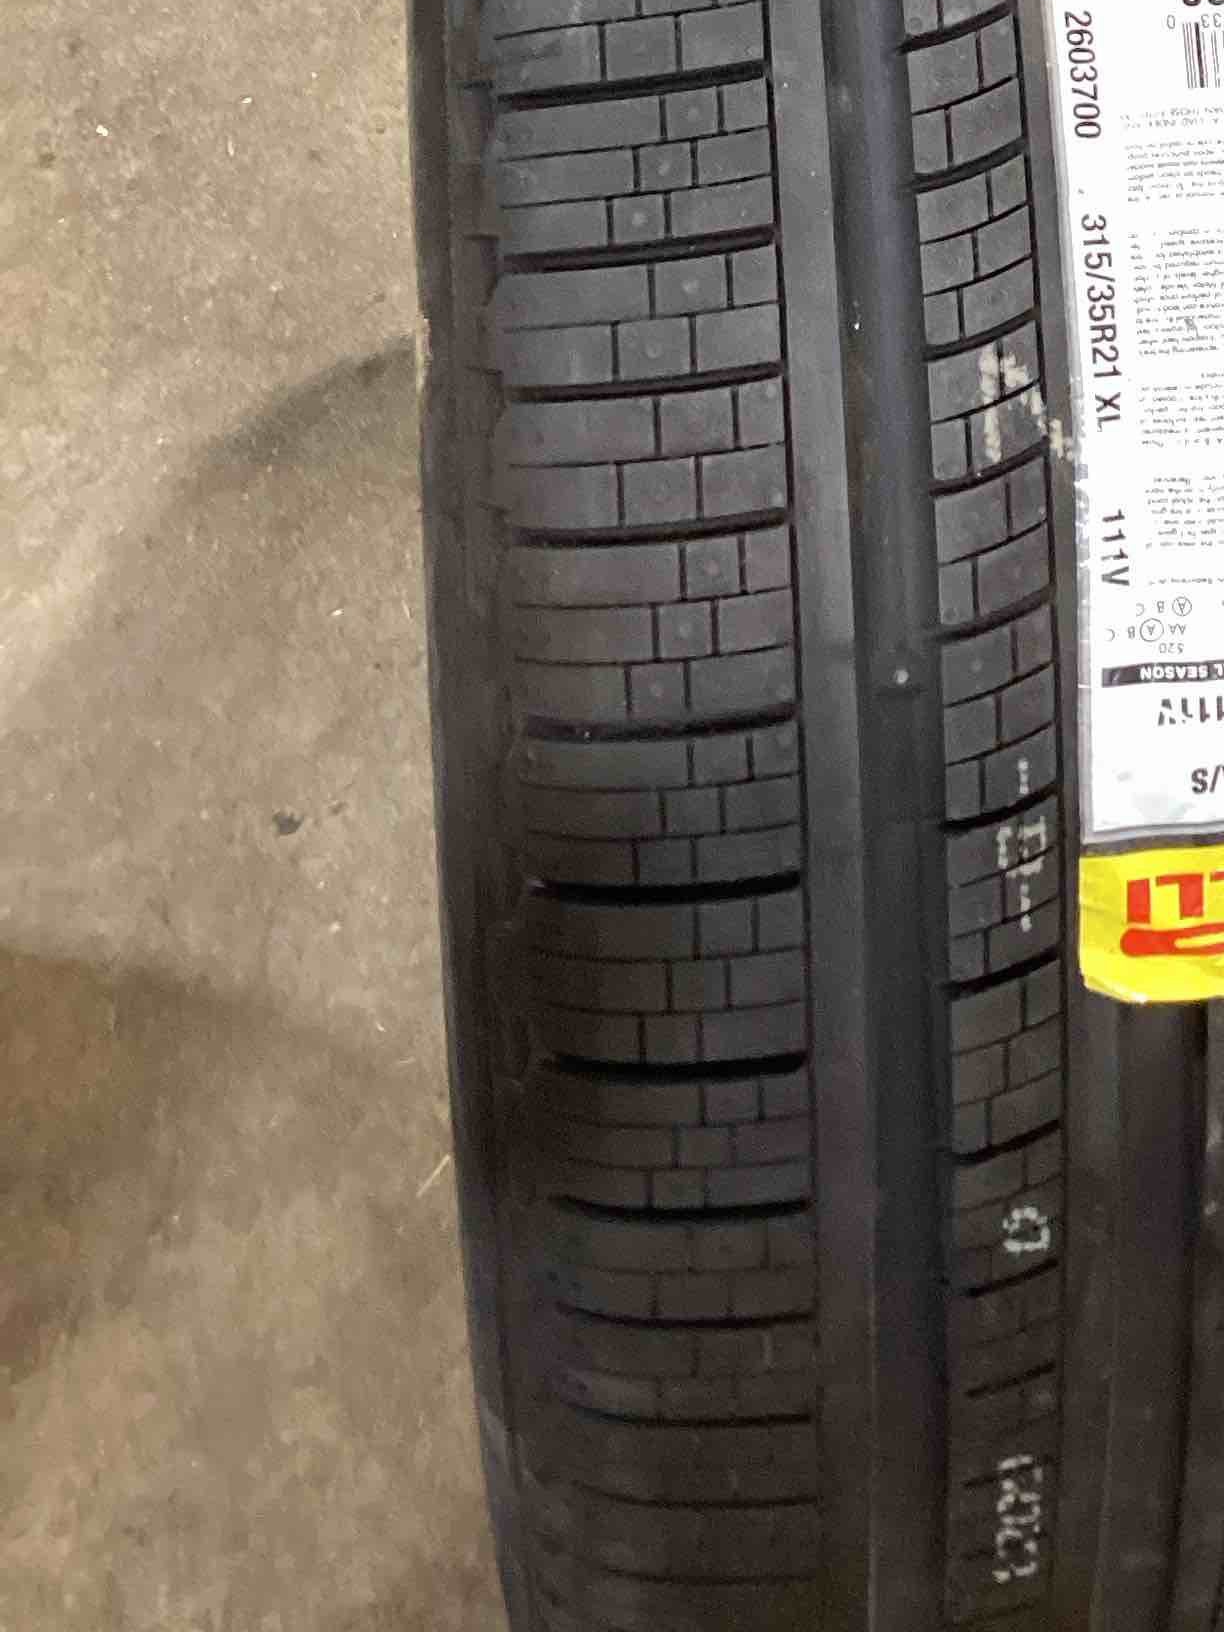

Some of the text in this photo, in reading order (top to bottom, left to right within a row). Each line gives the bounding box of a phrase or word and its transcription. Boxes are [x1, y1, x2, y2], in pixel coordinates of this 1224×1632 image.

[1166, 14, 1176, 29] 0
[1065, 10, 1130, 587] 2603700 315/35R21 XL 111V
[1140, 665, 1208, 680] SEASON
